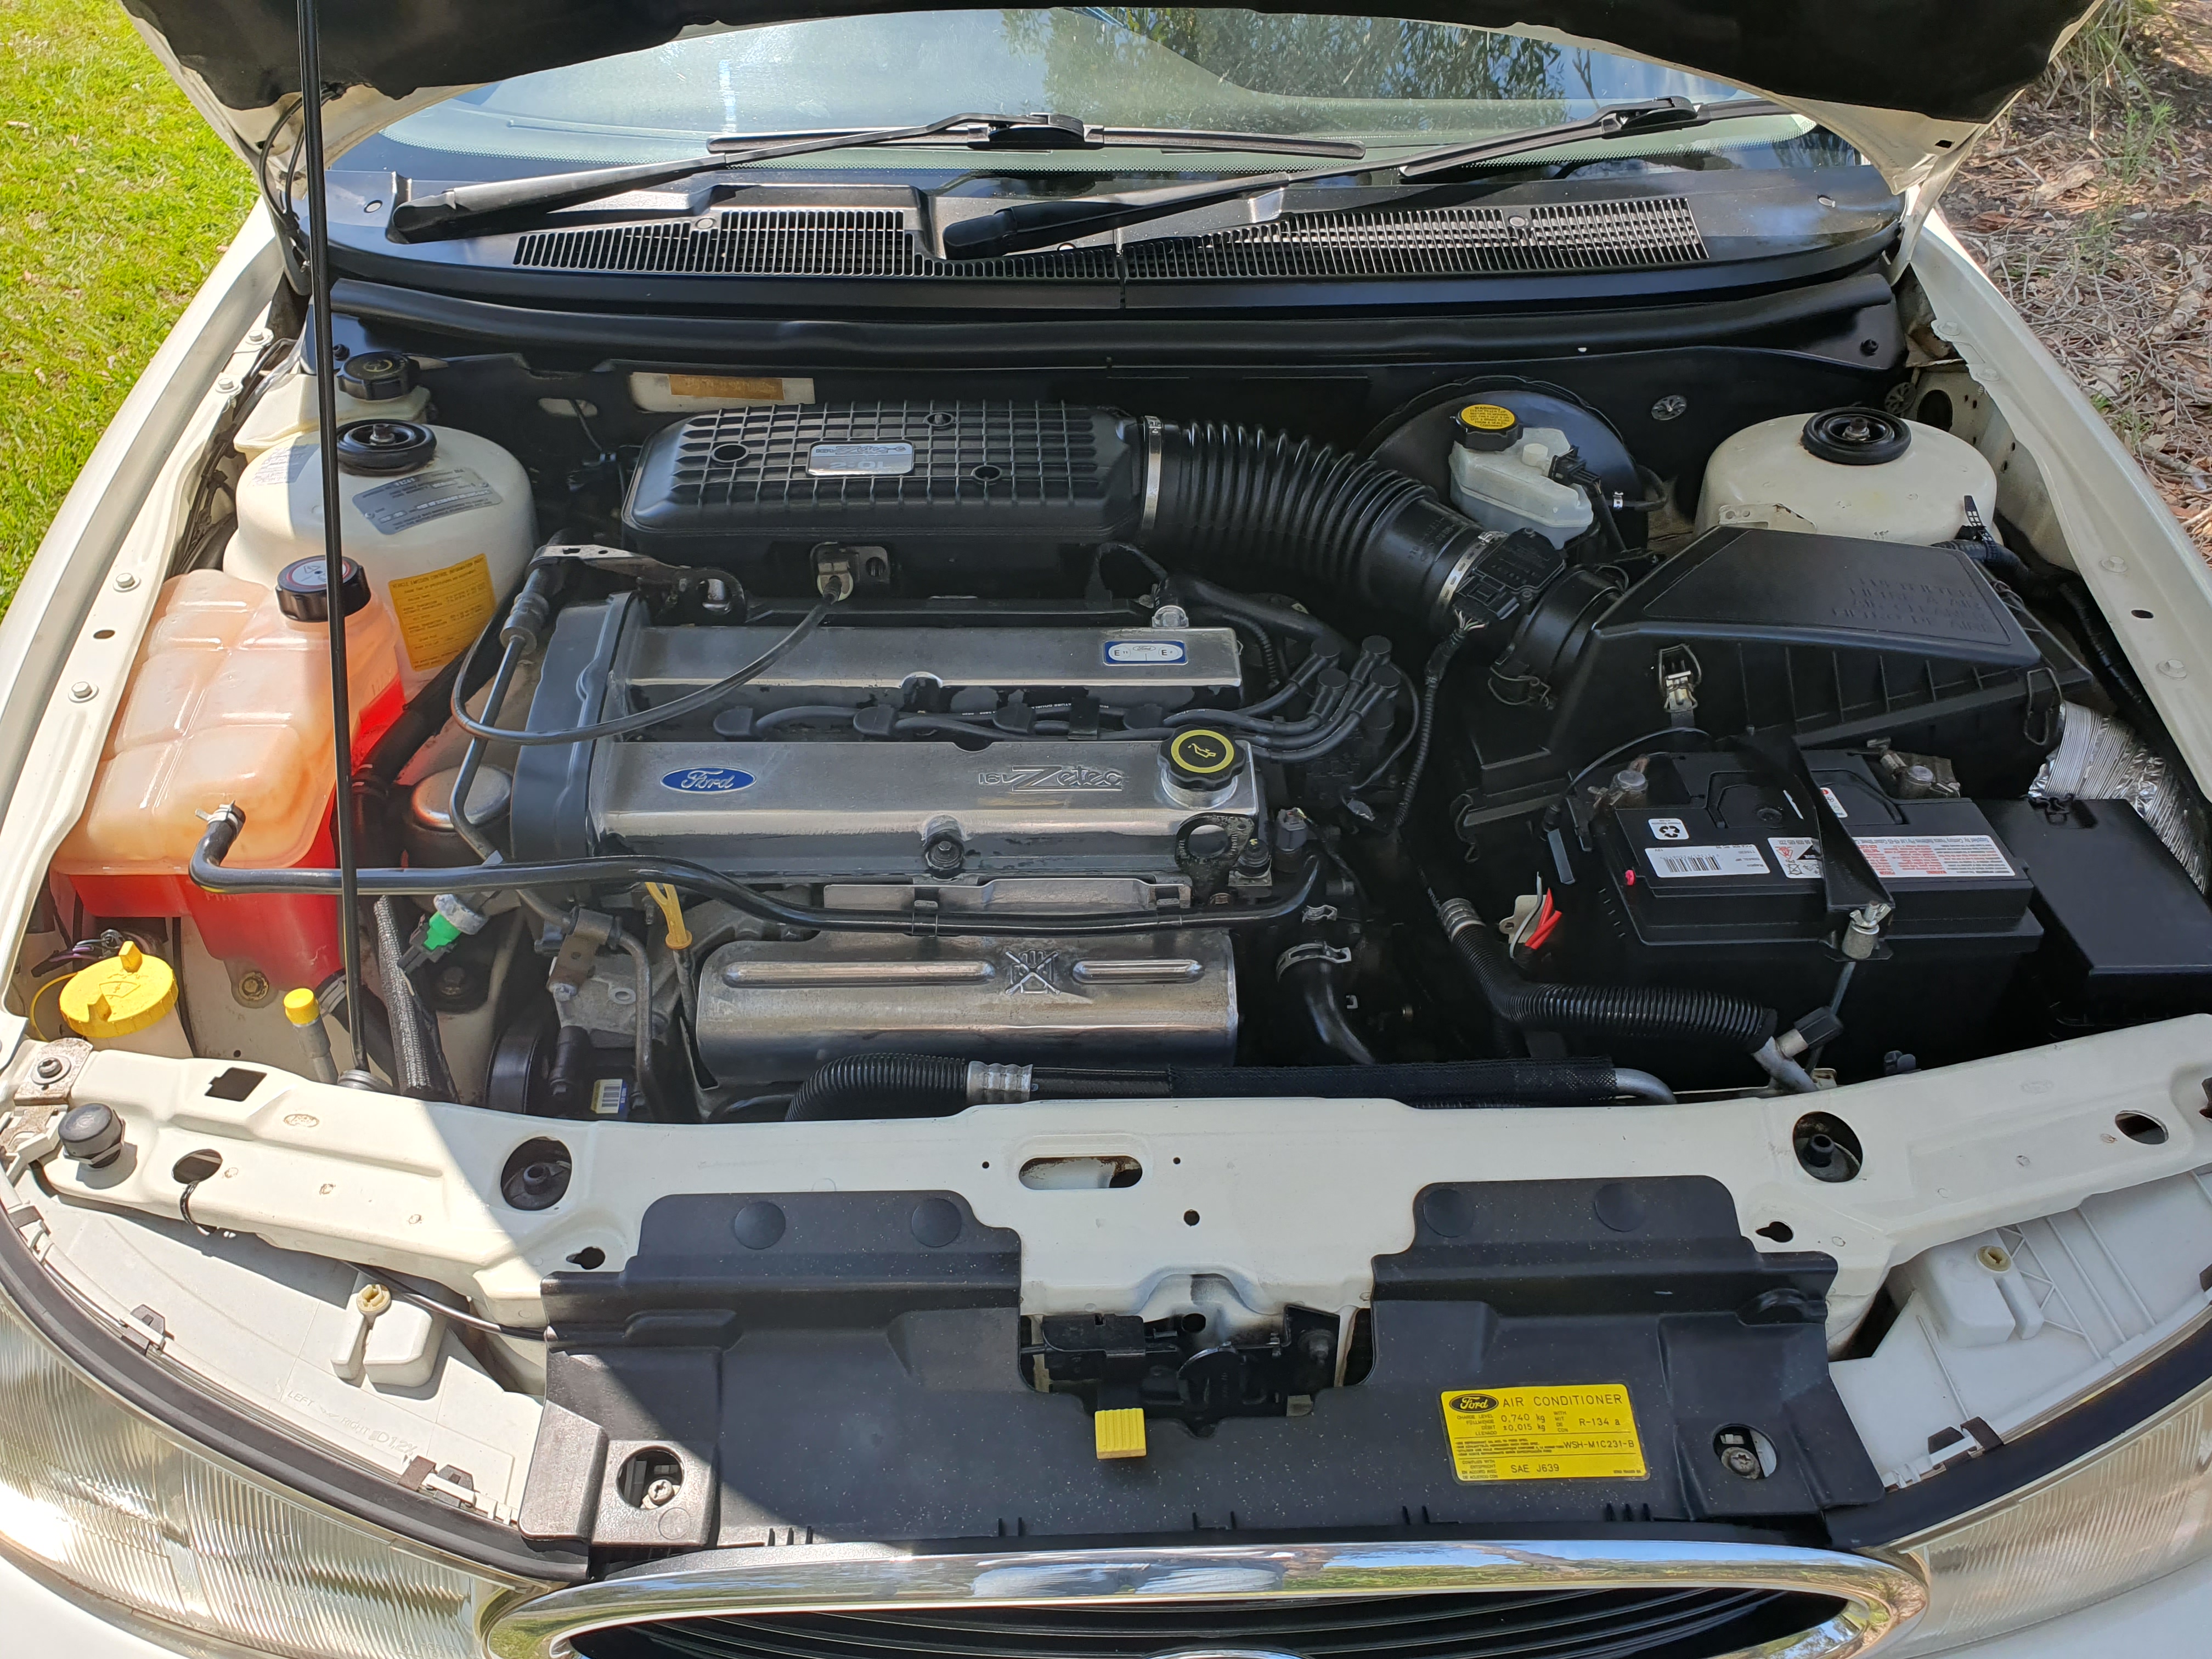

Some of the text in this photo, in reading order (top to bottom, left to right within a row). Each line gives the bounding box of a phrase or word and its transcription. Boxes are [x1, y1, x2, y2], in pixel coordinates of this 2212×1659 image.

[681, 769, 735, 789] Ford
[978, 765, 1124, 792] 16V Zetec
[1460, 1396, 1488, 1409] Ford
[1503, 1394, 1622, 1407] AIR CONDITIONER
[287, 1390, 315, 1407] LEFT
[341, 1417, 371, 1435] RIGHT
[1536, 1414, 1545, 1423] kg
[1579, 1418, 1609, 1426] R-134
[1537, 1424, 1545, 1432] kg
[1563, 1440, 1635, 1449] WSH-M1C231-B
[1510, 1464, 1559, 1474] SAE J639
